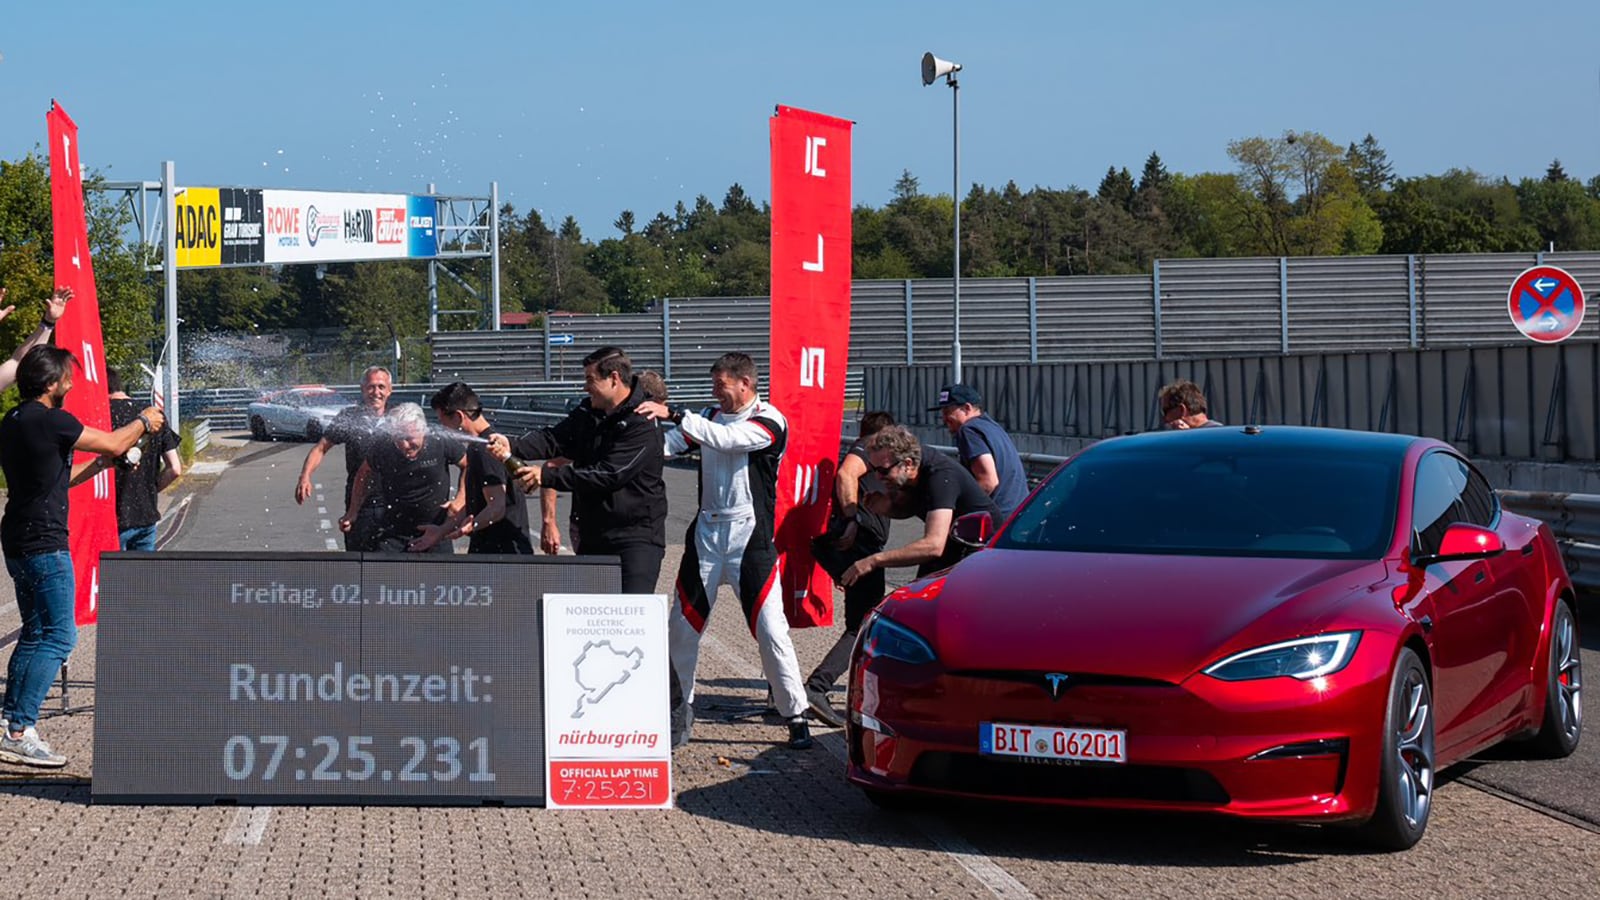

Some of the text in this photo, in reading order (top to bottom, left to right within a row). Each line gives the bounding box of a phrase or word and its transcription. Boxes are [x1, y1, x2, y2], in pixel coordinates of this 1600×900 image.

[175, 204, 217, 249] ADAC
[267, 206, 300, 234] ROWE
[343, 208, 362, 239] H&R
[378, 219, 405, 242] auto
[230, 582, 493, 609] Freitag, 02. Juni 2023
[565, 605, 645, 617] NORDSCHLEIFE
[586, 618, 625, 628] ELECTRIC
[566, 627, 646, 637] PRODUCTION CARS
[229, 661, 493, 703] Rundenzeit:
[558, 730, 659, 749] nürburgring
[994, 727, 1121, 759] BIT 06201
[222, 735, 497, 782] 07:25.231
[559, 768, 659, 779] OFFICIAL LAP TIME
[561, 779, 653, 801] 7:25.231
